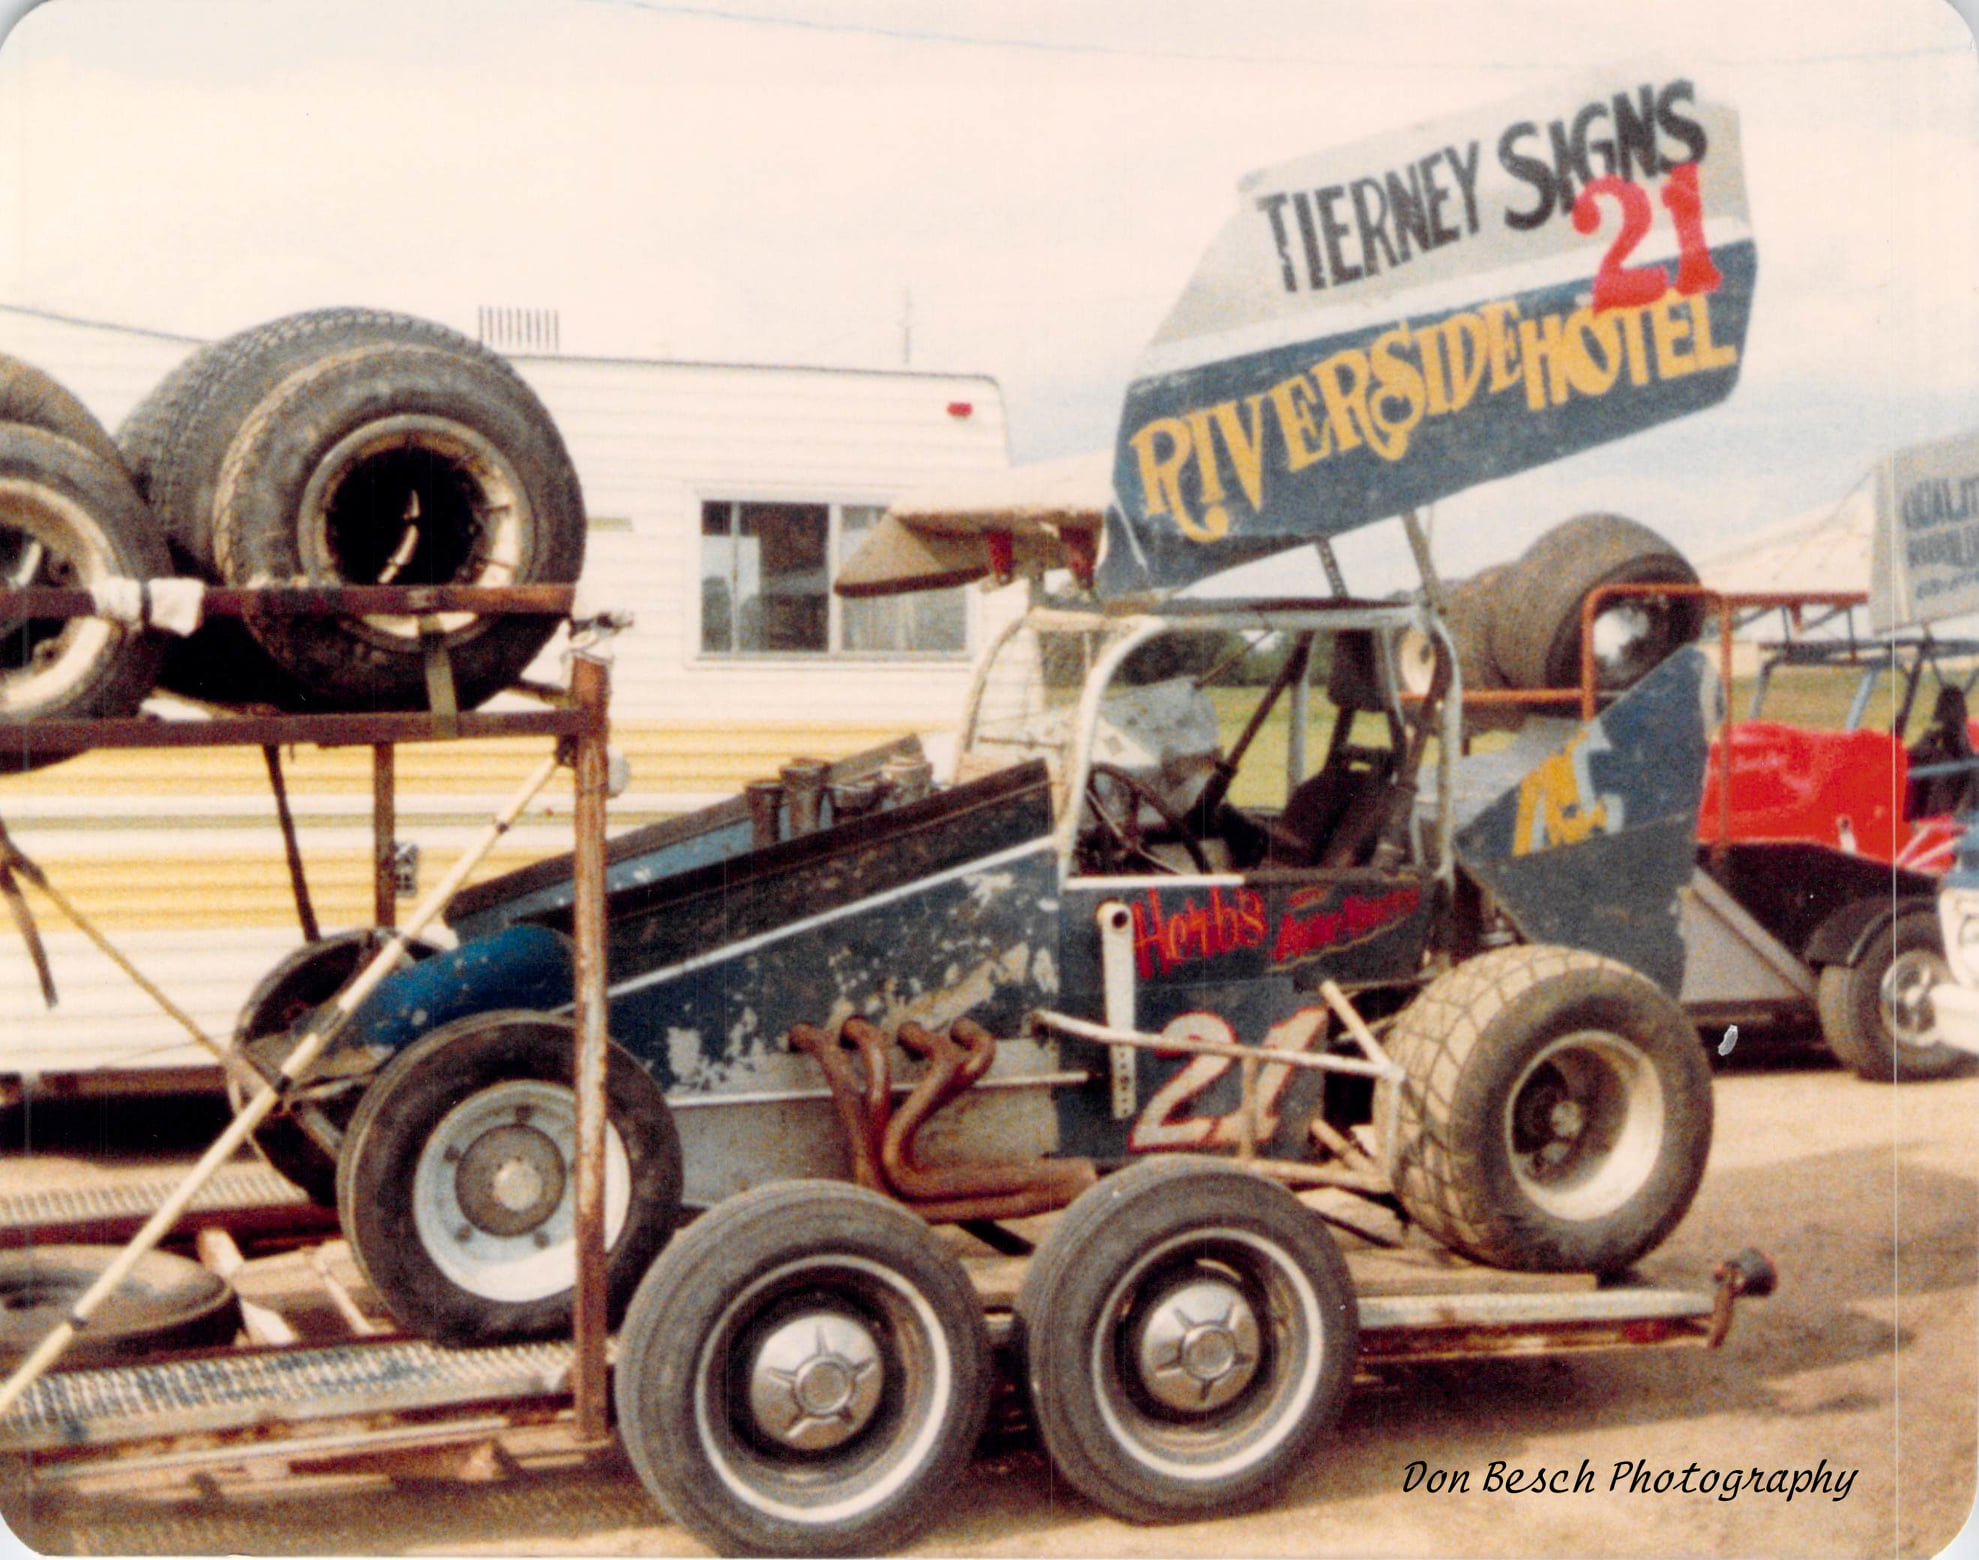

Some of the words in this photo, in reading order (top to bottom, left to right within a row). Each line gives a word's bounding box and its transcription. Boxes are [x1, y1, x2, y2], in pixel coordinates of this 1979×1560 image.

[1258, 140, 1480, 292] TIERNEY
[1499, 78, 1707, 231] SIGNS
[1571, 161, 1723, 316] 21
[1129, 301, 1523, 543] RIVERSIDE
[1516, 288, 1738, 411] HOTEL
[1128, 1006, 1328, 1153] 21
